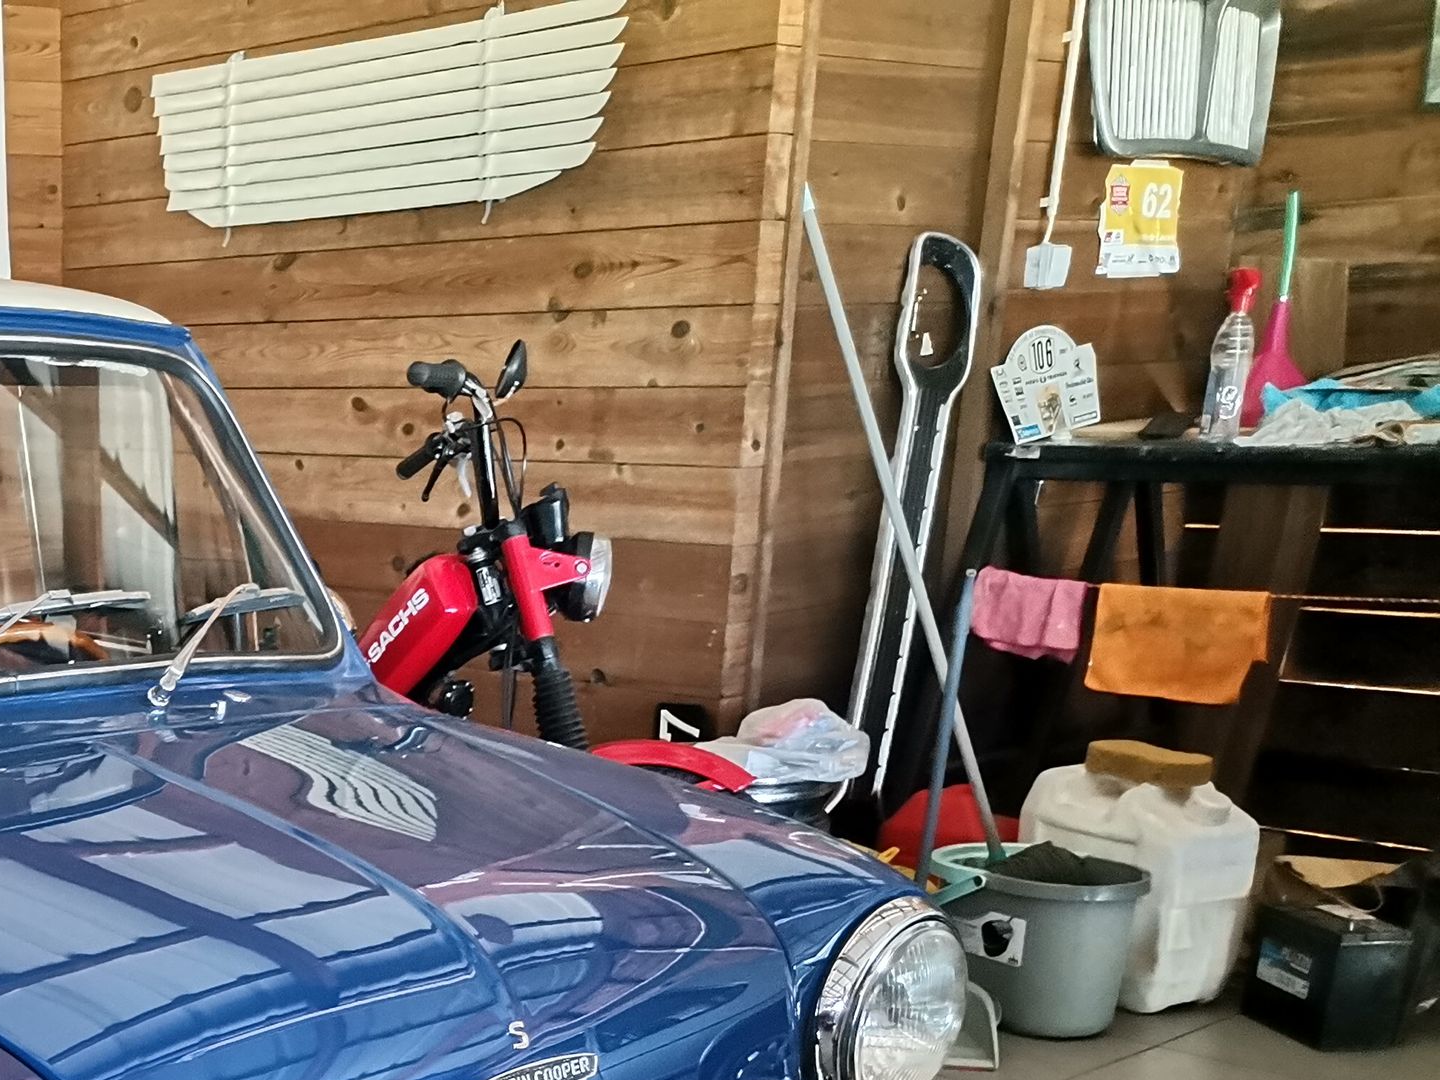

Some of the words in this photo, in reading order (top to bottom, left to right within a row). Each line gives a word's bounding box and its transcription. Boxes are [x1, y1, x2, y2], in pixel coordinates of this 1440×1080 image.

[1142, 182, 1173, 219] 62
[1031, 338, 1053, 371] 106
[367, 588, 430, 666] SACHS
[507, 1020, 530, 1050] S
